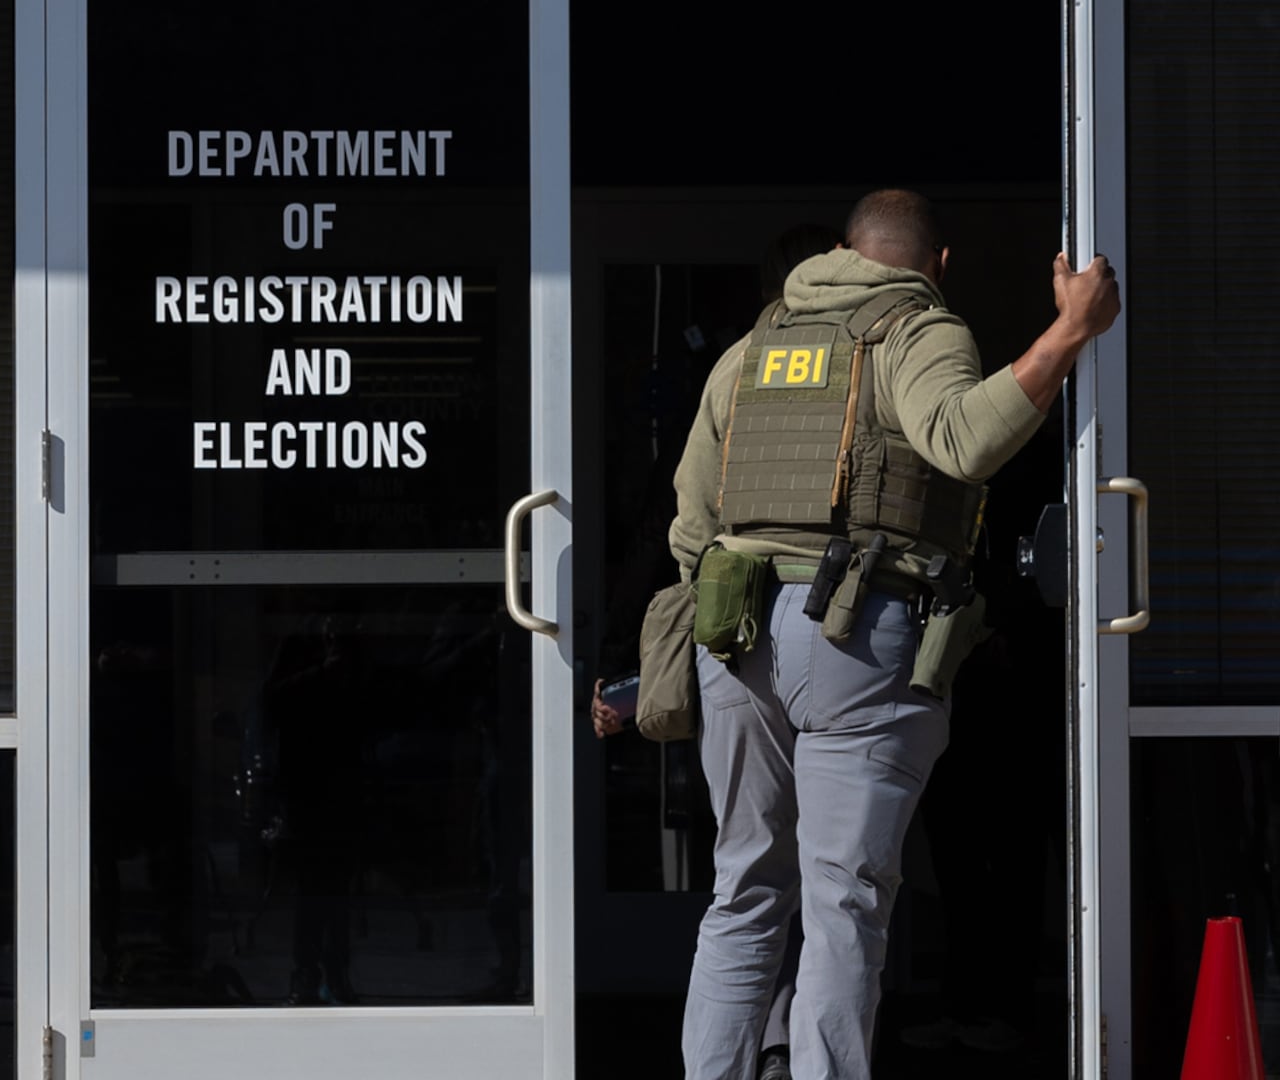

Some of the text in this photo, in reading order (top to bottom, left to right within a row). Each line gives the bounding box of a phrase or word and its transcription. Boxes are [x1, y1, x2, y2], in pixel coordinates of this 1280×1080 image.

[167, 130, 453, 177] DEPARTMENT
[283, 202, 337, 250] OF
[155, 275, 464, 324] REGISTRATION
[265, 348, 352, 396] AND
[762, 348, 825, 385] FBI
[193, 420, 427, 470] ELECTIONS
